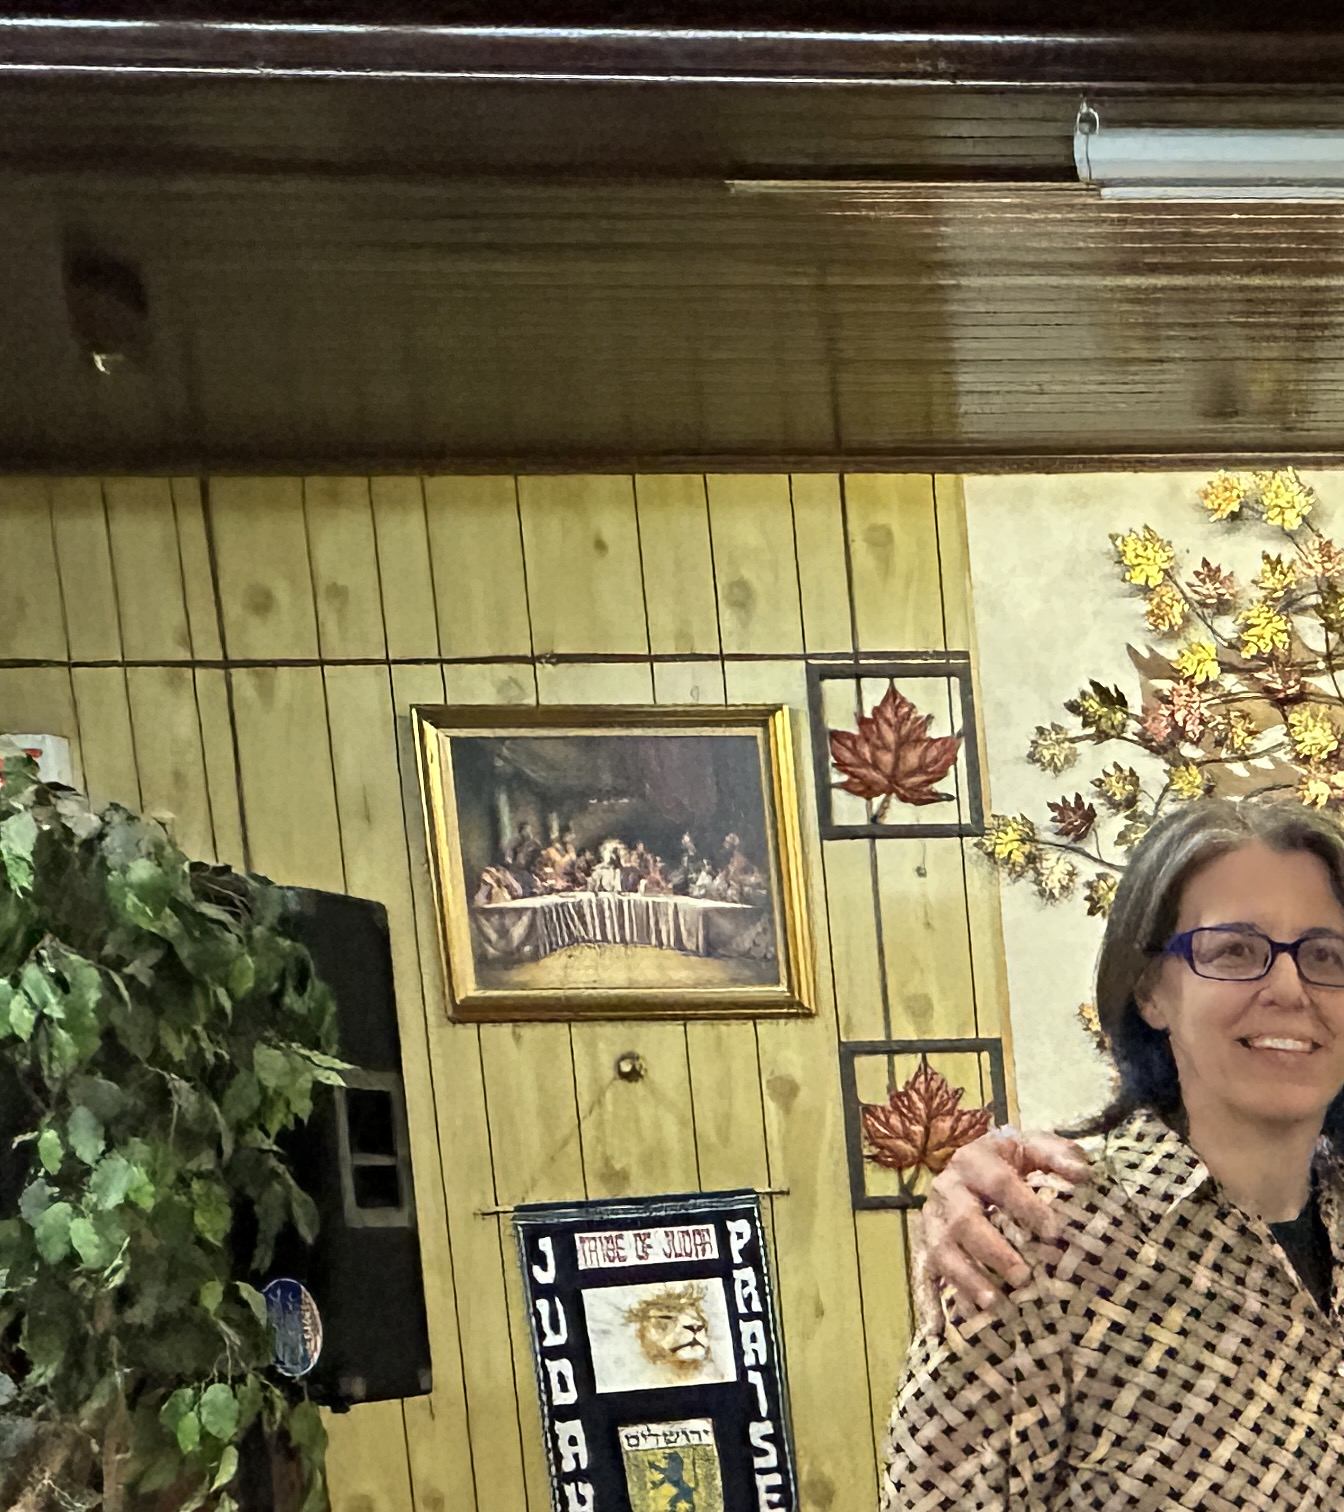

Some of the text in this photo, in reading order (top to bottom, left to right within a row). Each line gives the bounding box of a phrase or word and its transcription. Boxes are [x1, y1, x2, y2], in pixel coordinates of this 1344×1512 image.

[579, 1228, 713, 1267] TRIBE OF JUDAH
